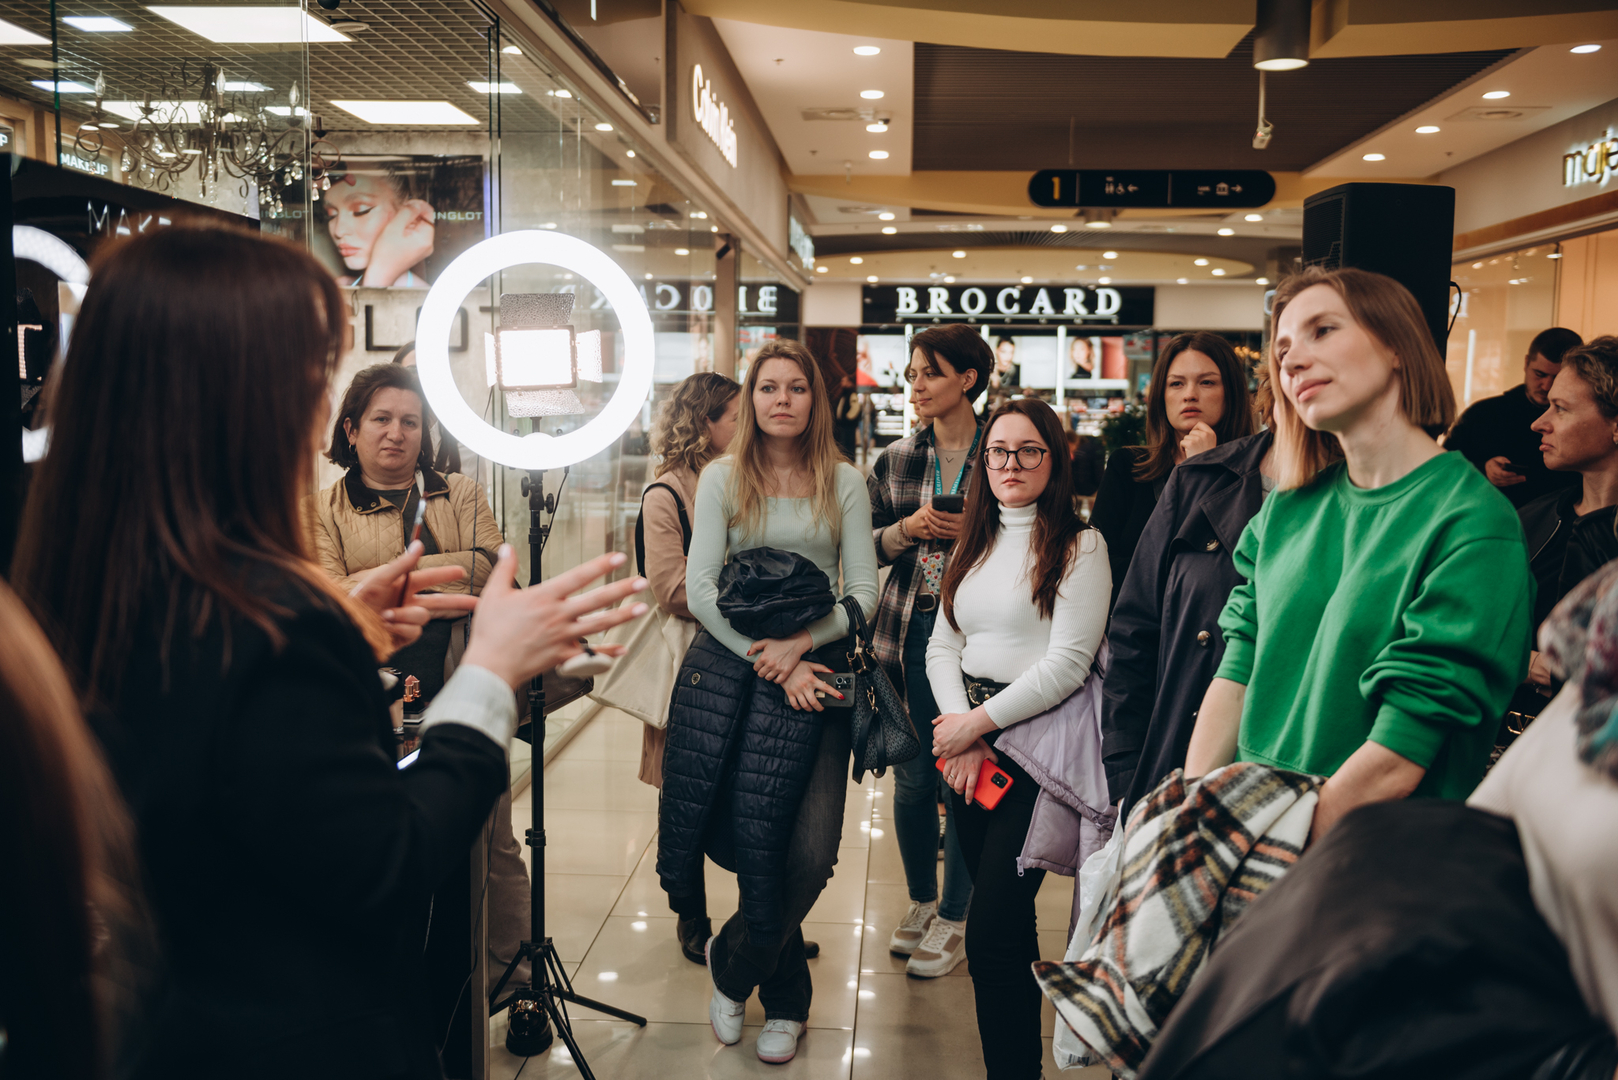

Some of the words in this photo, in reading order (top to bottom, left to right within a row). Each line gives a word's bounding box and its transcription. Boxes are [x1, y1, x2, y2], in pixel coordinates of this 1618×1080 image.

[1052, 177, 1060, 200] 1
[433, 211, 483, 221] INGLOT
[896, 286, 1122, 315] BROCARD
